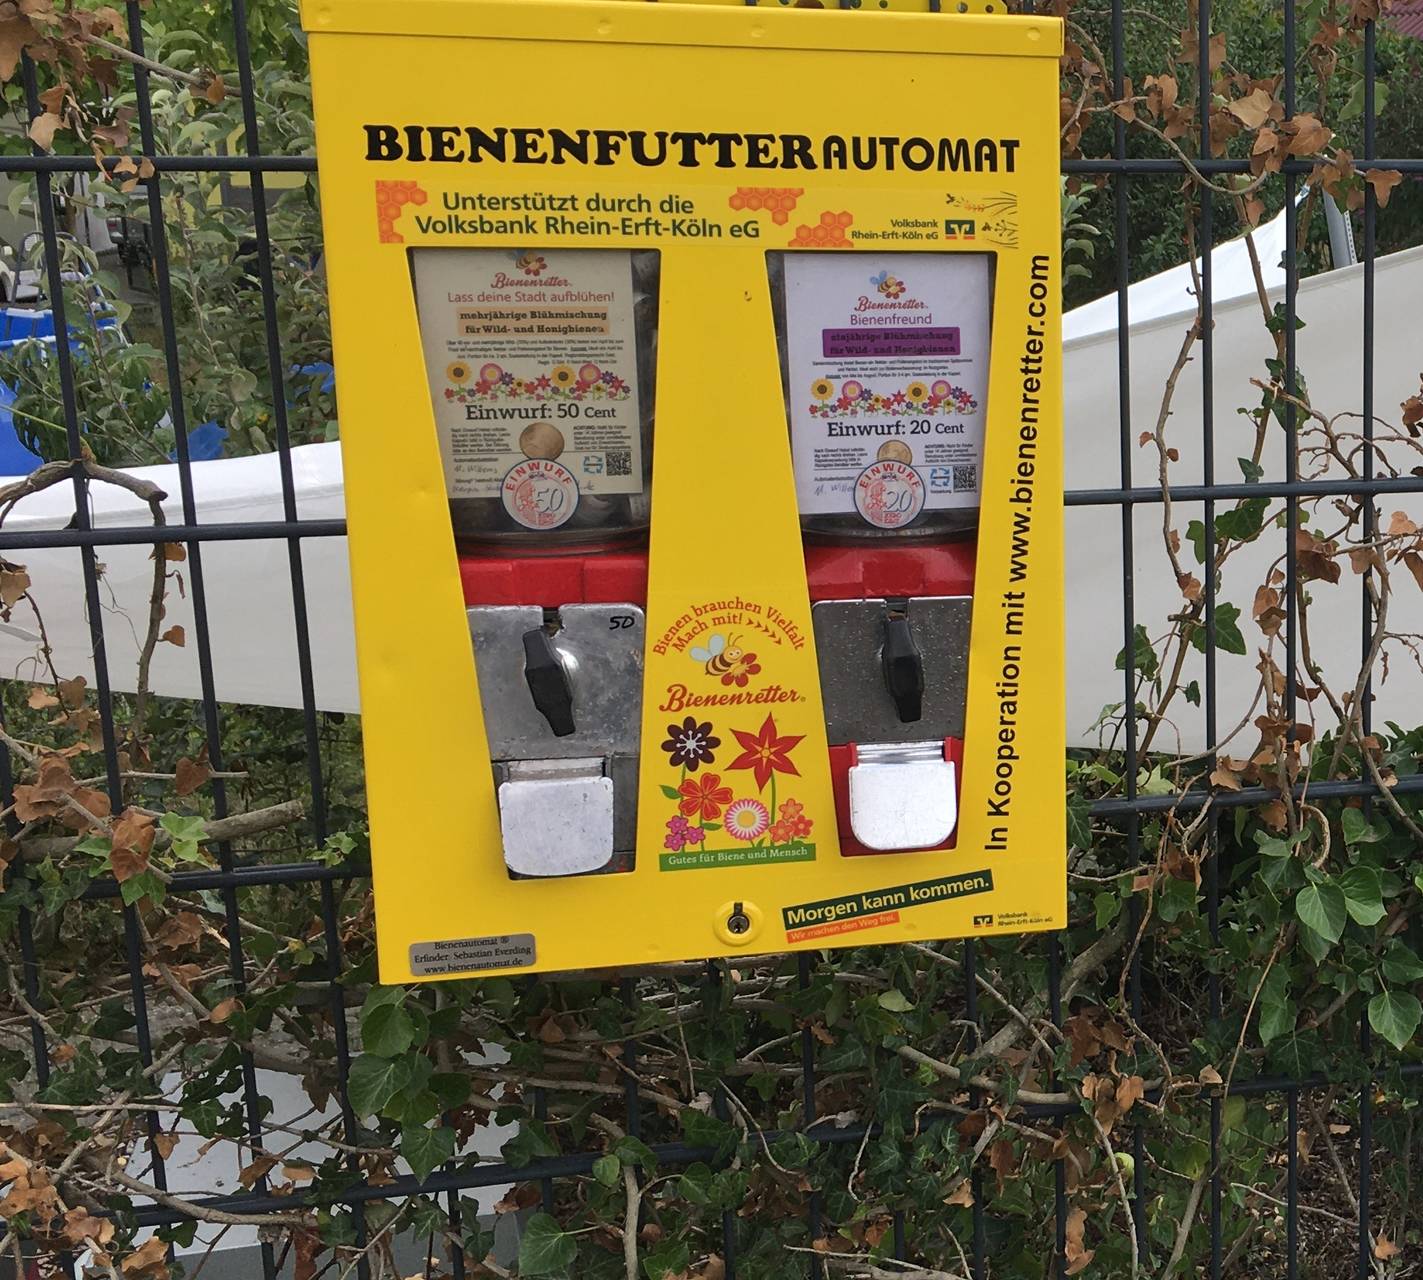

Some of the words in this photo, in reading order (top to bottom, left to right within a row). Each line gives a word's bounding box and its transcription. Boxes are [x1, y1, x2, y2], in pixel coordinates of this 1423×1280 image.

[442, 192, 577, 214] Unterstützt
[585, 193, 651, 213] durch
[659, 196, 694, 214] die
[415, 215, 537, 235] Volksbank
[545, 216, 721, 239] Rhein-Erft-Köln
[729, 222, 760, 239] eG
[890, 219, 938, 228] Volksbank
[851, 231, 923, 240] Rhein-Erft-Köln
[926, 232, 939, 240] eG
[490, 272, 570, 289] Bienenretter
[448, 292, 474, 303] Lass
[478, 292, 511, 303] deine
[515, 291, 548, 303] Stadt
[551, 291, 614, 304] aufblühen!
[854, 296, 925, 312] Bienenretter
[460, 309, 527, 322] mehrjährige
[530, 309, 607, 321] Blühmischung
[850, 313, 932, 326] Bienenfreund
[466, 324, 481, 335] für
[484, 324, 511, 334] Wild-
[514, 323, 534, 334] und
[537, 323, 605, 336] Honigbienen
[466, 404, 552, 420] Einwurf:
[557, 403, 579, 418] 50
[584, 406, 616, 418] Cent
[1007, 255, 1049, 583] www.bienenretter.com
[827, 421, 906, 437] Einwurf:
[910, 420, 931, 435] 20
[935, 423, 964, 434] Cent
[505, 462, 573, 491] EINWURF
[859, 464, 922, 488] EINWURF
[536, 487, 564, 514] 50
[886, 489, 912, 513] 20
[609, 615, 635, 630] 50
[1002, 591, 1025, 635] mit
[653, 613, 693, 656] Bienen
[691, 596, 762, 617] brauchen
[766, 606, 805, 650] Vielfalt
[672, 620, 709, 653] Mach
[712, 612, 744, 626] mit!
[659, 683, 800, 713] Bienenretter
[986, 645, 1021, 817] Kooperation
[984, 827, 1008, 850] In
[668, 855, 697, 865] Gutes
[699, 853, 714, 863] für
[717, 852, 745, 862] Biene
[747, 849, 767, 859] und
[769, 847, 808, 858] Mensch
[786, 901, 858, 926] Morgen
[861, 889, 905, 911] kann
[909, 876, 990, 901] kommen.
[791, 930, 807, 941] Wir
[808, 926, 840, 938] machen
[860, 919, 879, 930] Weg
[880, 915, 897, 925] frei.
[434, 938, 498, 950] Bienenautomat
[453, 951, 492, 960] Sebastian
[494, 946, 531, 956] Everding
